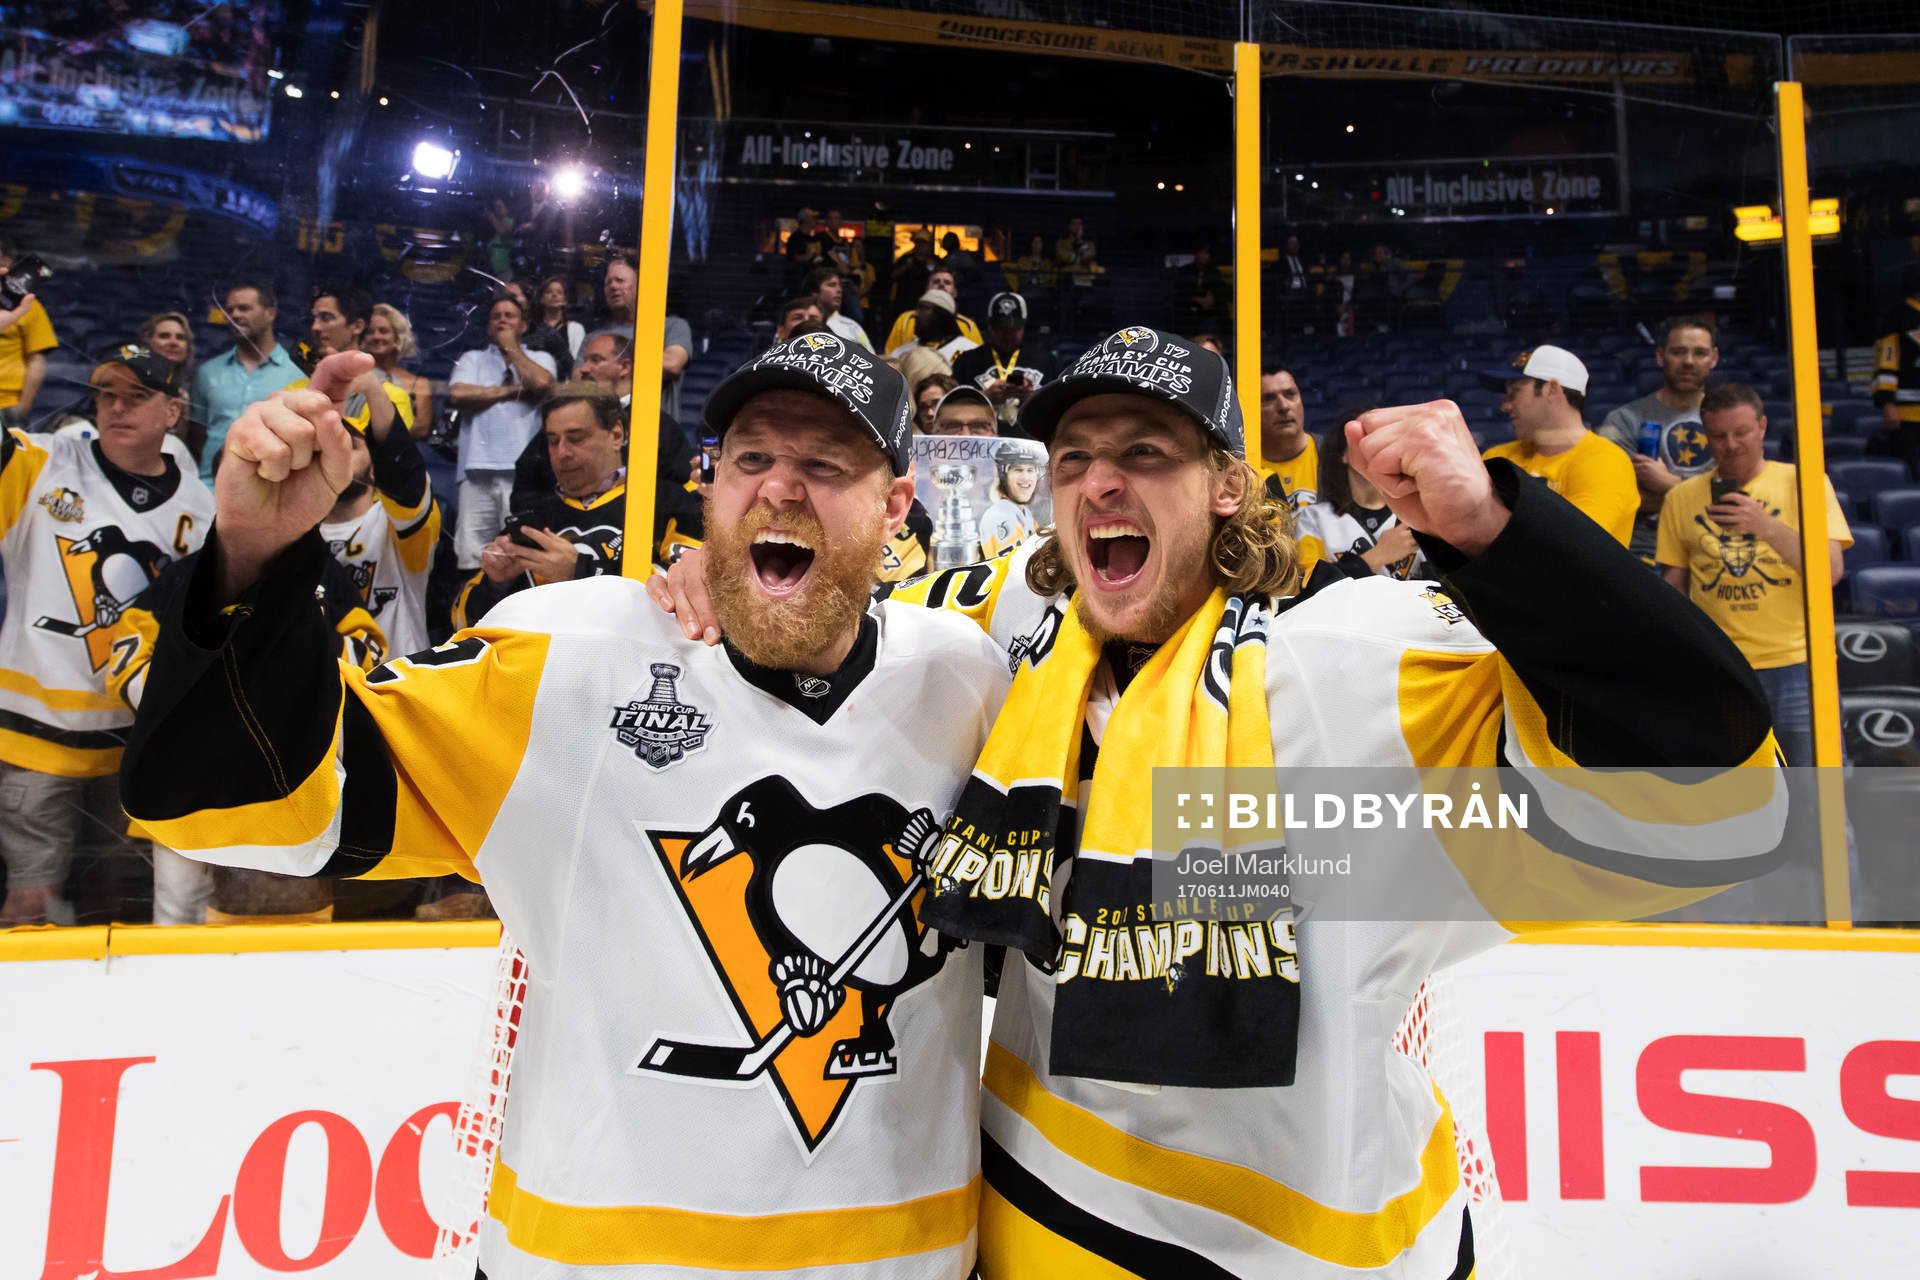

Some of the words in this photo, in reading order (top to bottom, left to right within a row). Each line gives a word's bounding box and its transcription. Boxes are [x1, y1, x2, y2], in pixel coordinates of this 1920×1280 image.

[938, 19, 1097, 51] BRIDGESTONE
[1105, 39, 1165, 59] ARENA
[1465, 55, 1680, 76] PREDATORS
[742, 135, 889, 168] All-Inclusive
[897, 139, 954, 170] Zone
[1385, 171, 1533, 206] All-Inclusive
[1541, 170, 1600, 200] Zone
[1163, 343, 1191, 359] 17
[849, 353, 873, 370] 17
[1156, 357, 1192, 374] CUP
[840, 365, 874, 385] CUP
[174, 512, 193, 557] C
[1717, 583, 1767, 600] HOCKEY
[629, 702, 673, 713] STANLEY
[673, 705, 696, 714] CUP
[616, 710, 708, 731] FINAL
[642, 731, 678, 739] 2017
[1007, 829, 1041, 846] CUP
